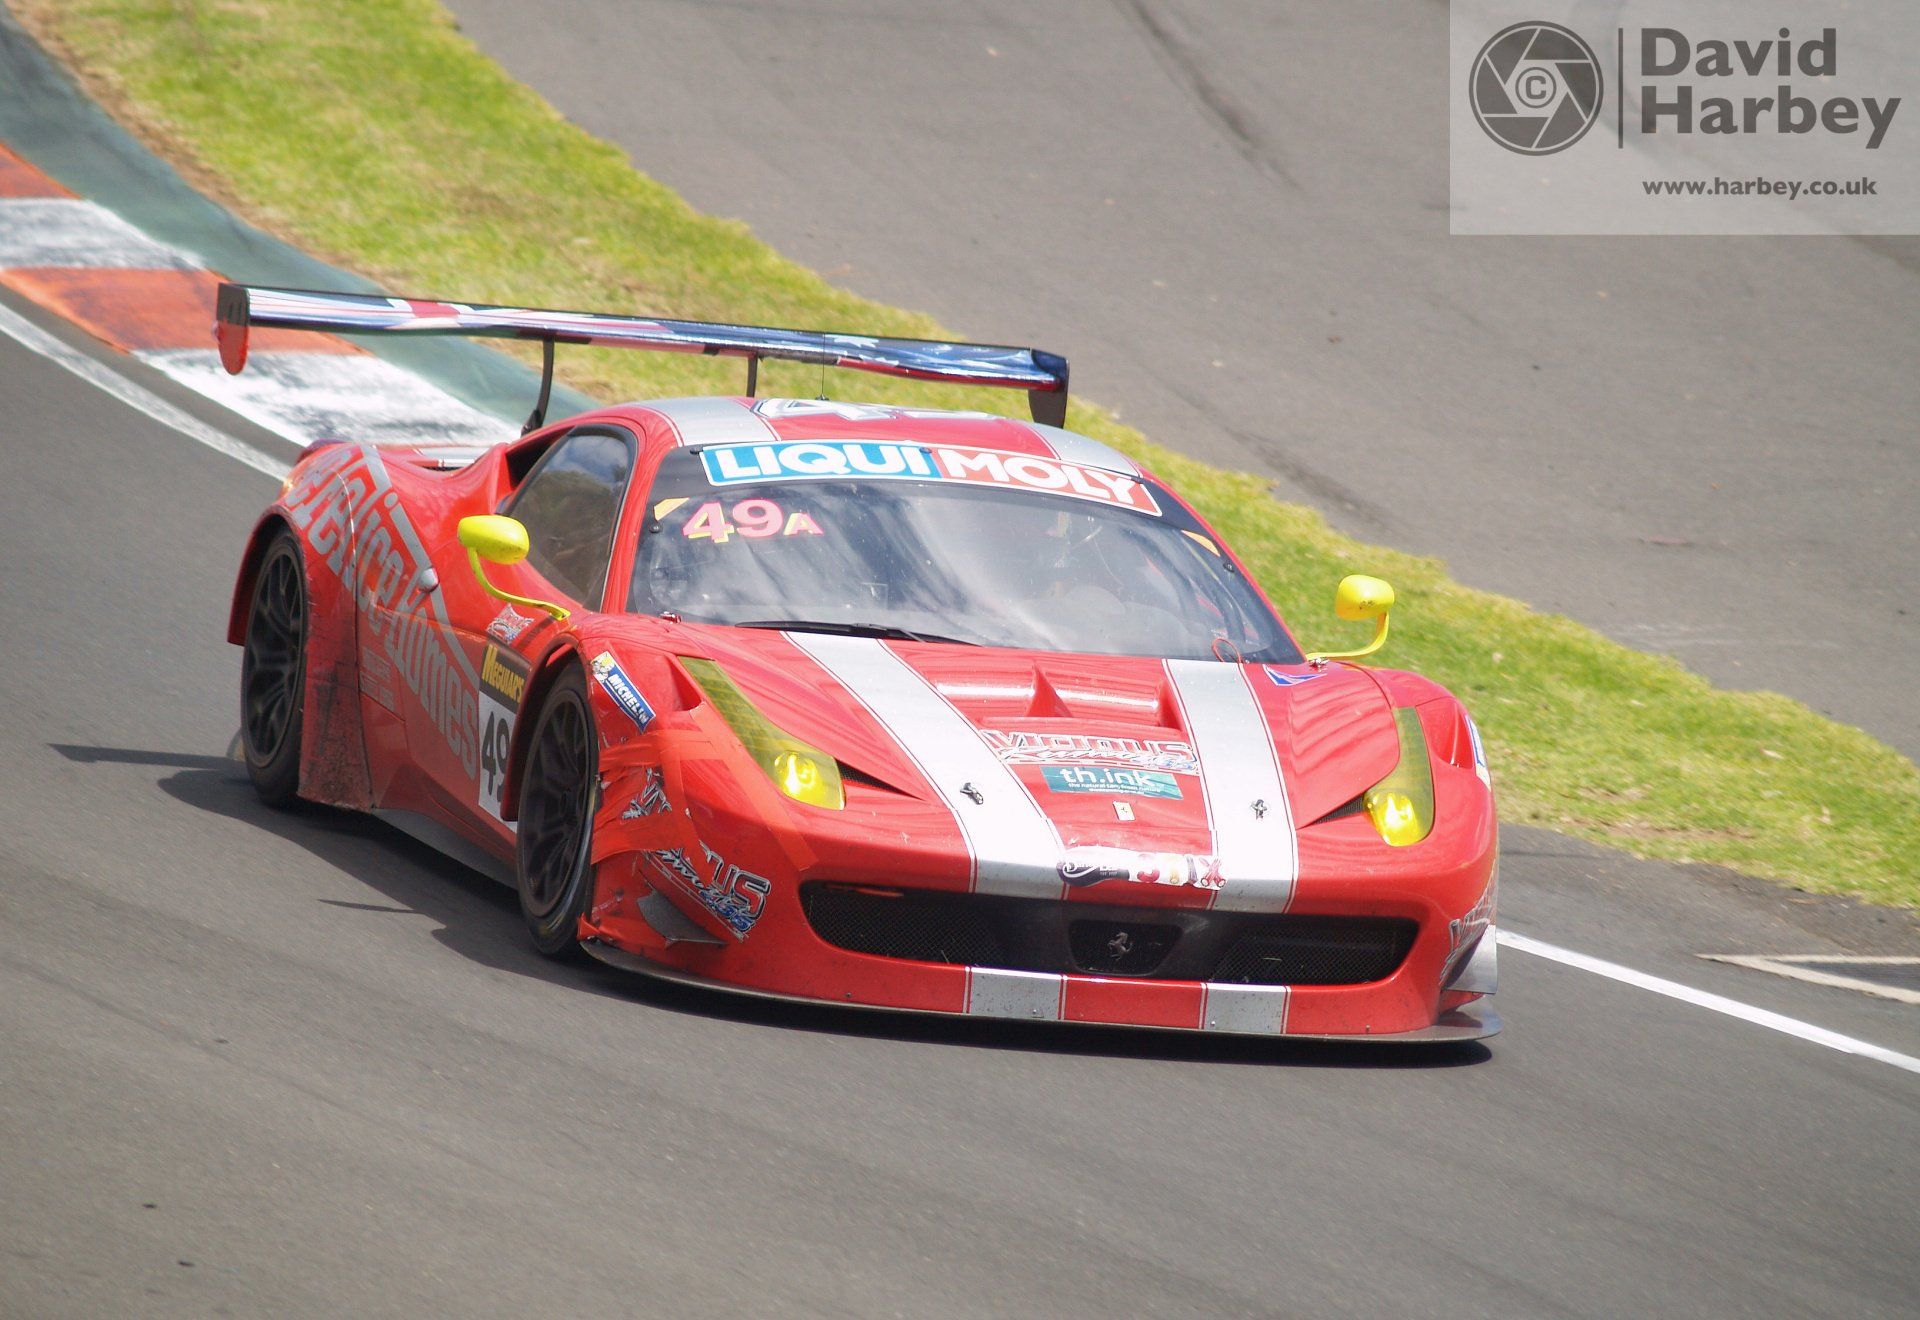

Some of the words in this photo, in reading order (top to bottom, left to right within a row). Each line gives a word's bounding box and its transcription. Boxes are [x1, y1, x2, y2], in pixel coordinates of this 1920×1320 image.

[714, 443, 935, 479] LIQUI
[937, 448, 1139, 508] MOLY
[607, 672, 650, 725] MICHELIN
[481, 710, 511, 804] 49
[1060, 766, 1156, 787] th.ink
